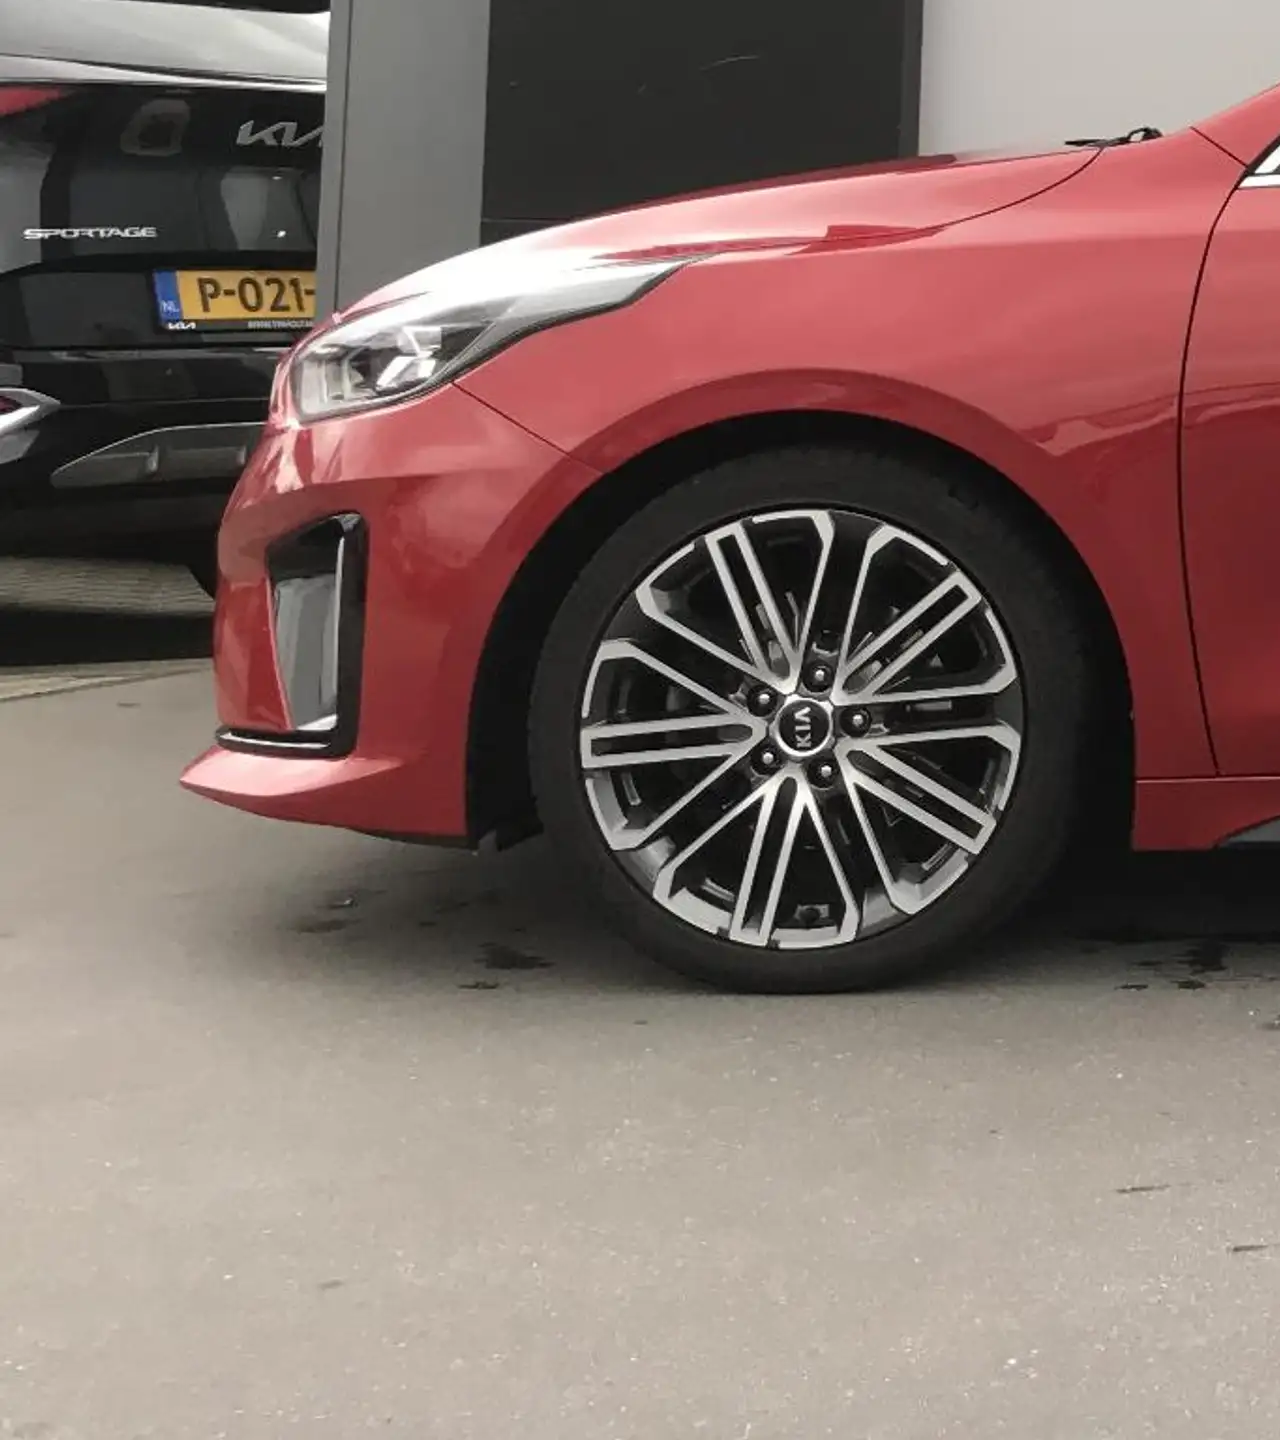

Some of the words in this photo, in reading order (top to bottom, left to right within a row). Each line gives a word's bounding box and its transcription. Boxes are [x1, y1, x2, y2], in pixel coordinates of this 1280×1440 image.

[22, 227, 157, 239] SPORTAGE
[160, 300, 180, 313] NL
[795, 706, 812, 748] KIA
